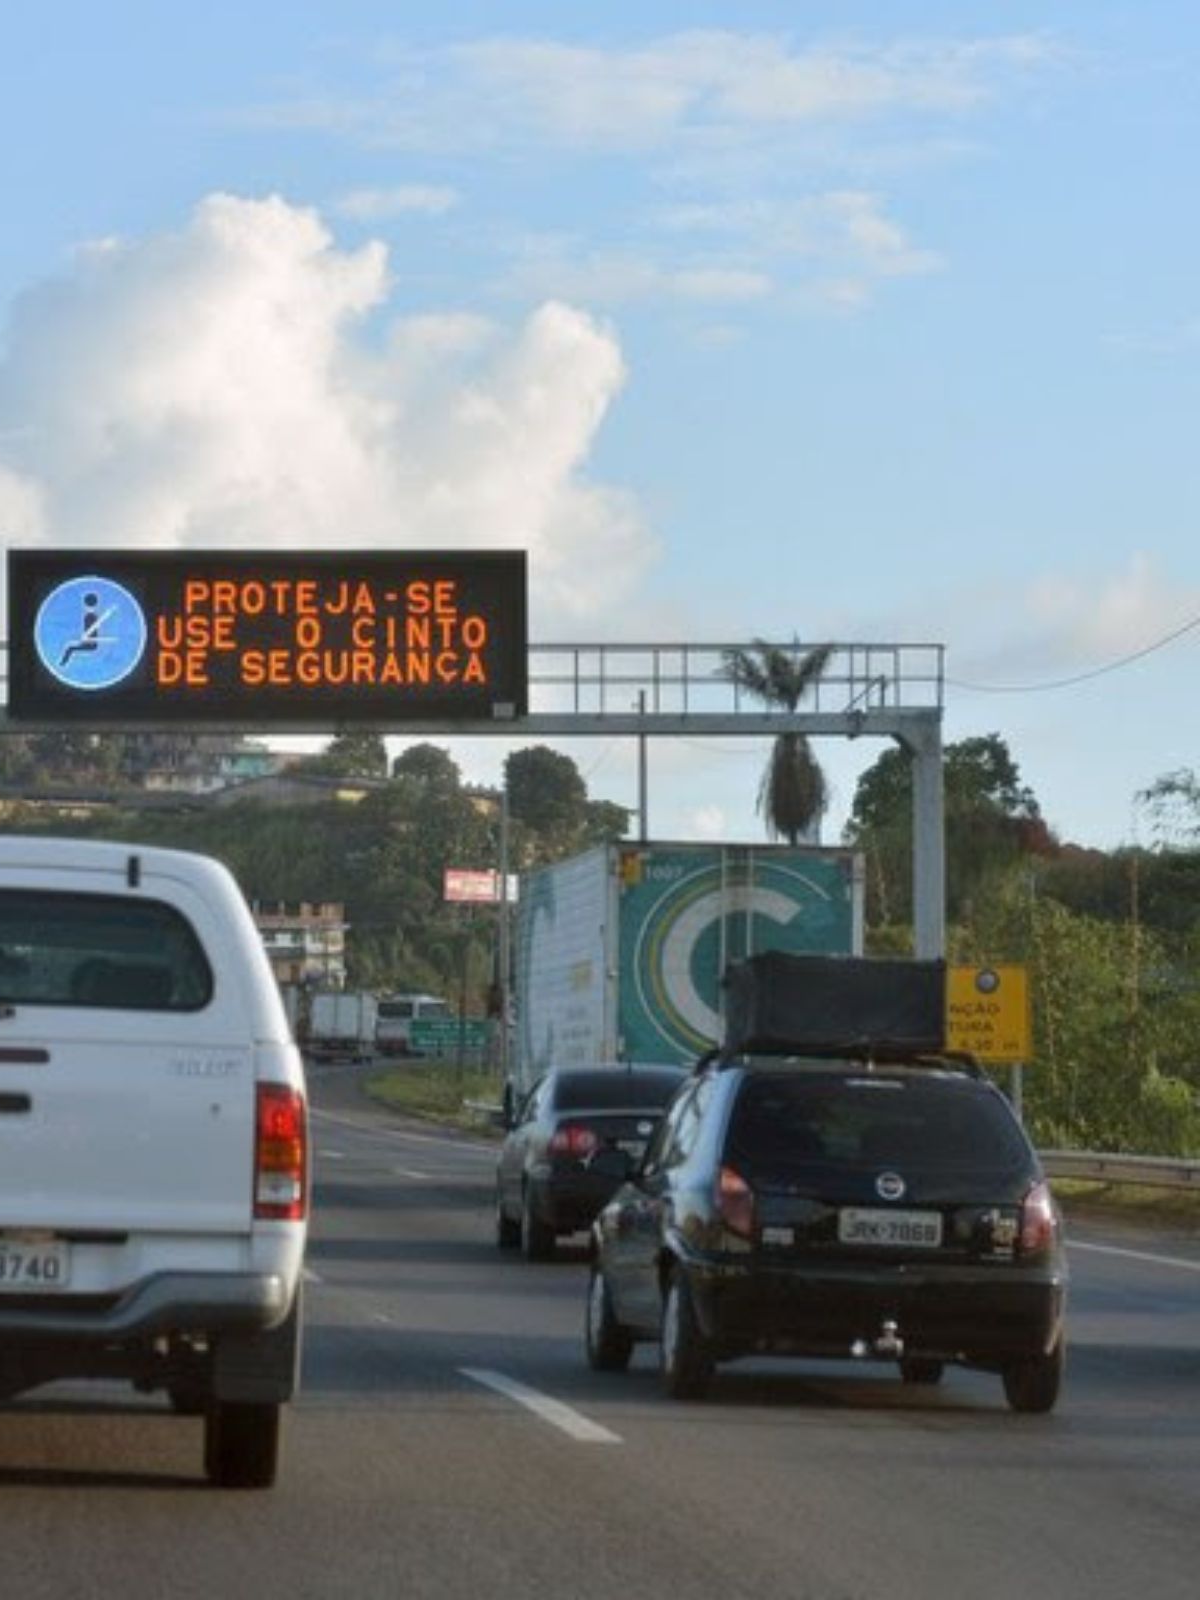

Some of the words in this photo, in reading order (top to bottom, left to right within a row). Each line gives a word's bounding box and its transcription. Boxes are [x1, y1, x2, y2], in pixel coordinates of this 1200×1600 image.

[185, 580, 458, 615] PROTEJA-SE
[157, 616, 237, 649] USE
[296, 616, 321, 649] O
[352, 615, 487, 649] CINTO
[157, 650, 208, 684] DE
[240, 650, 487, 684] SEGURANÇA
